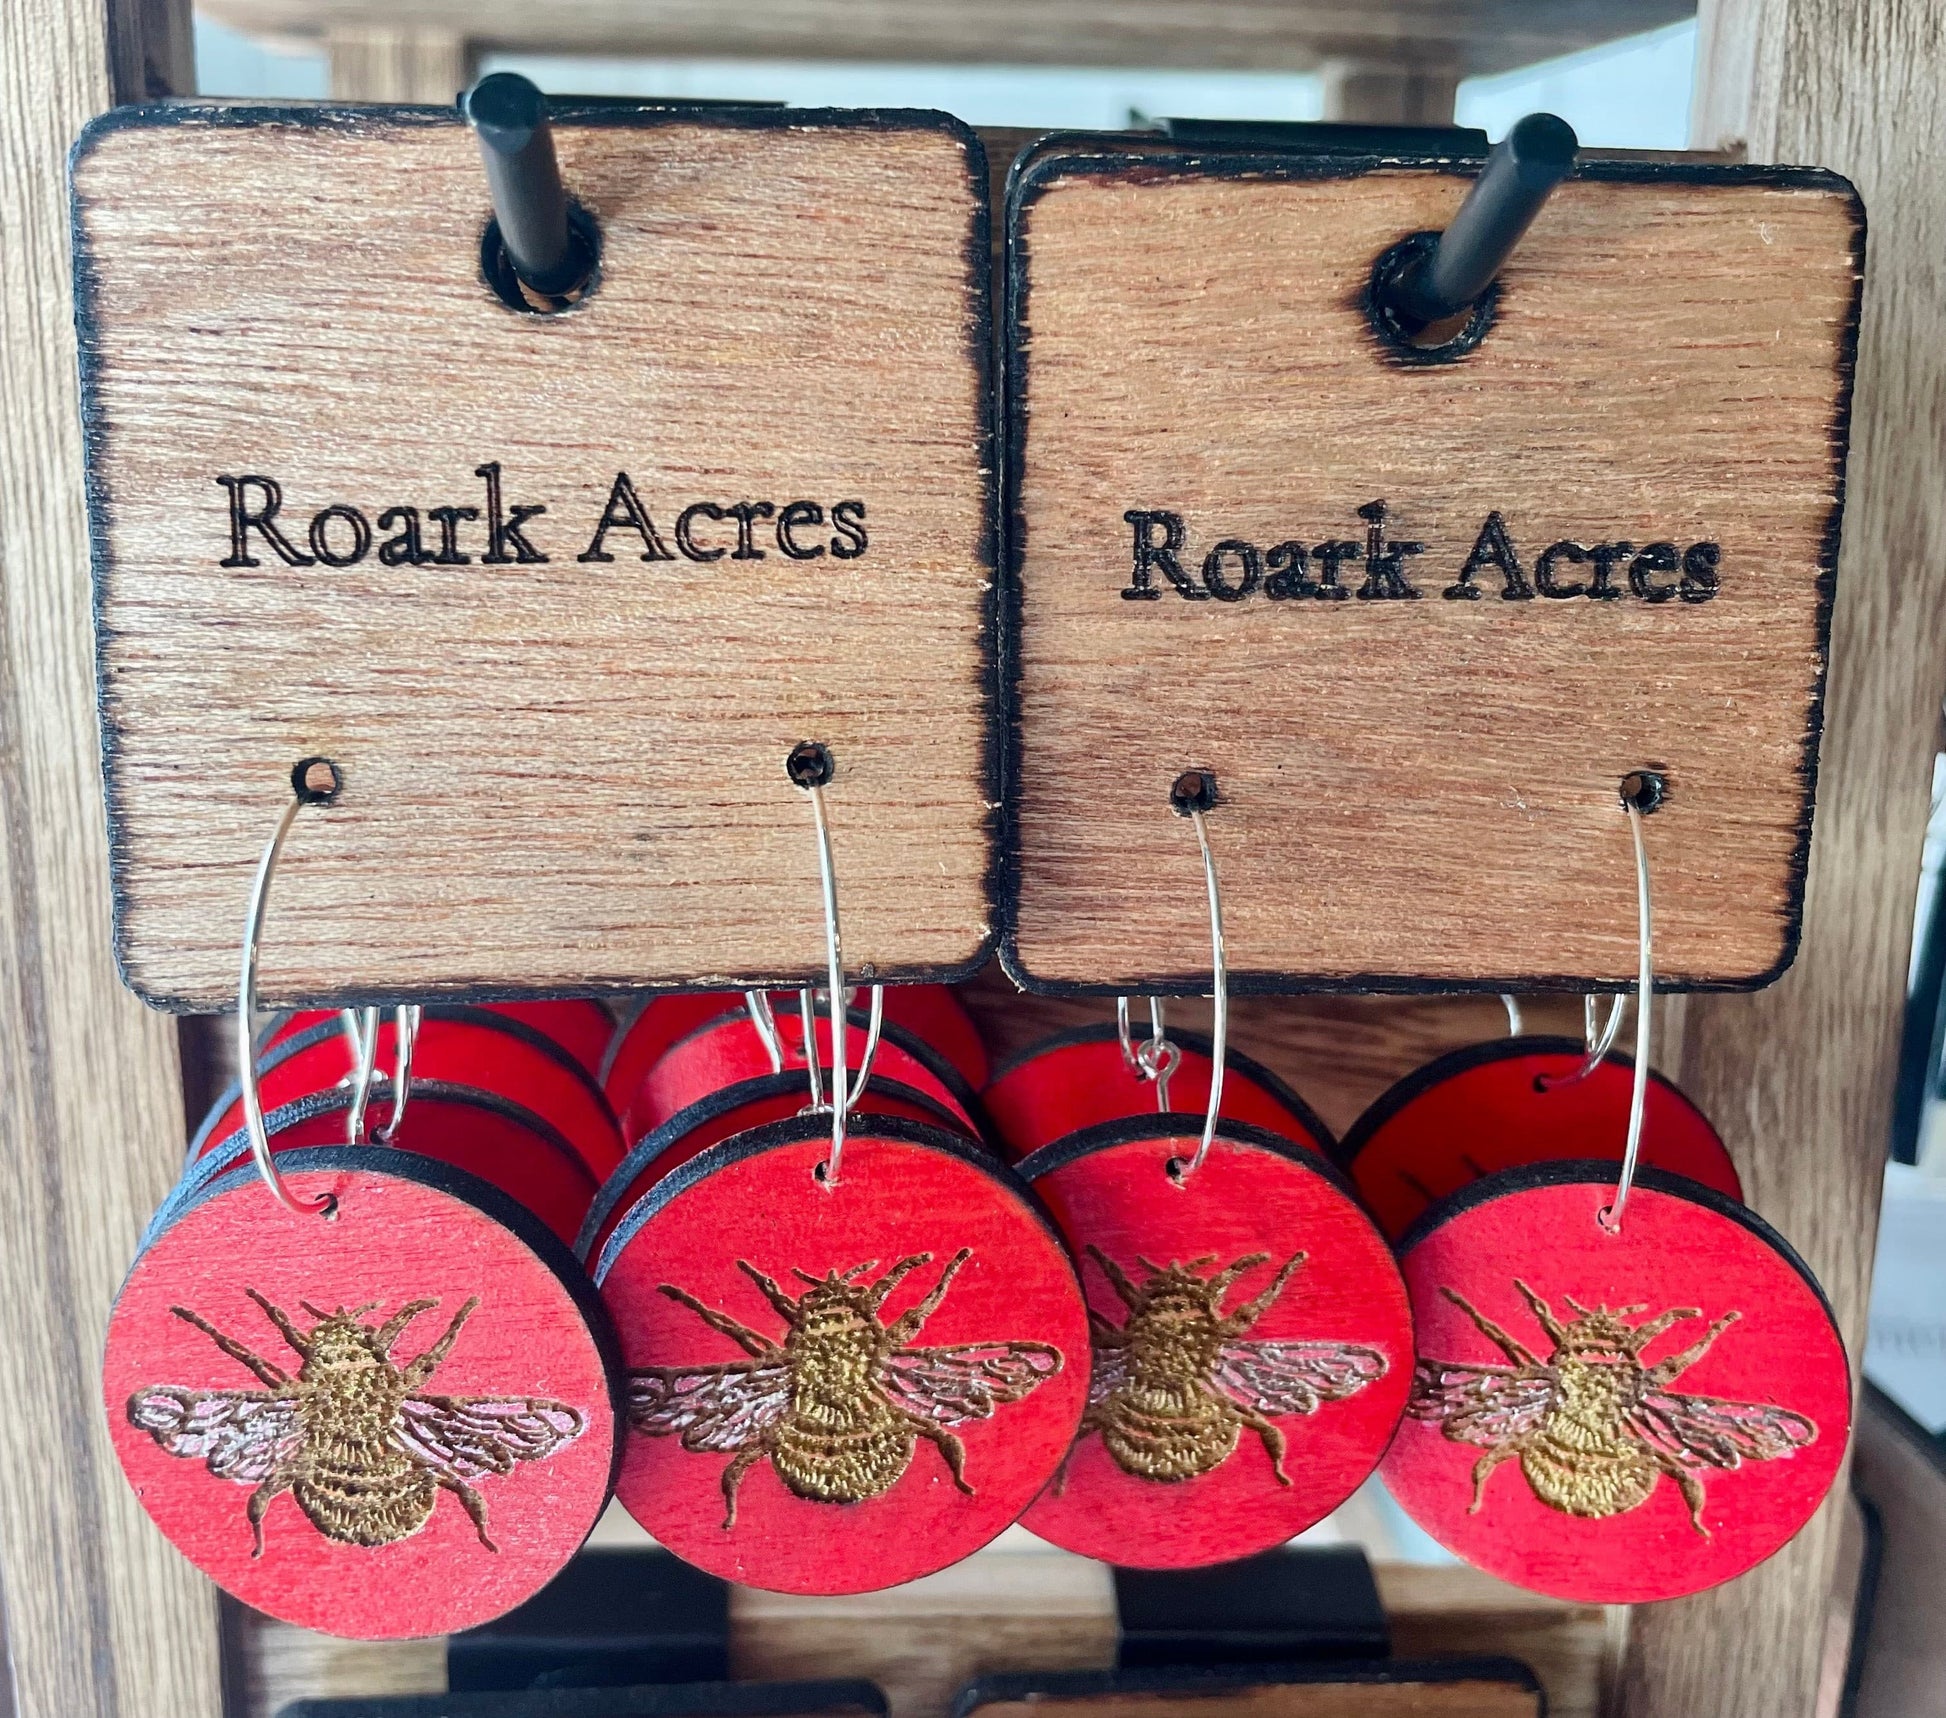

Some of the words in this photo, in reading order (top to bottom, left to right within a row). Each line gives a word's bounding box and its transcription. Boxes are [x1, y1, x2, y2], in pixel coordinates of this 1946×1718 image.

[215, 462, 551, 568] Roark
[577, 471, 869, 564] Acres
[1121, 498, 1426, 601] Roark
[1442, 509, 1721, 602] Acres
